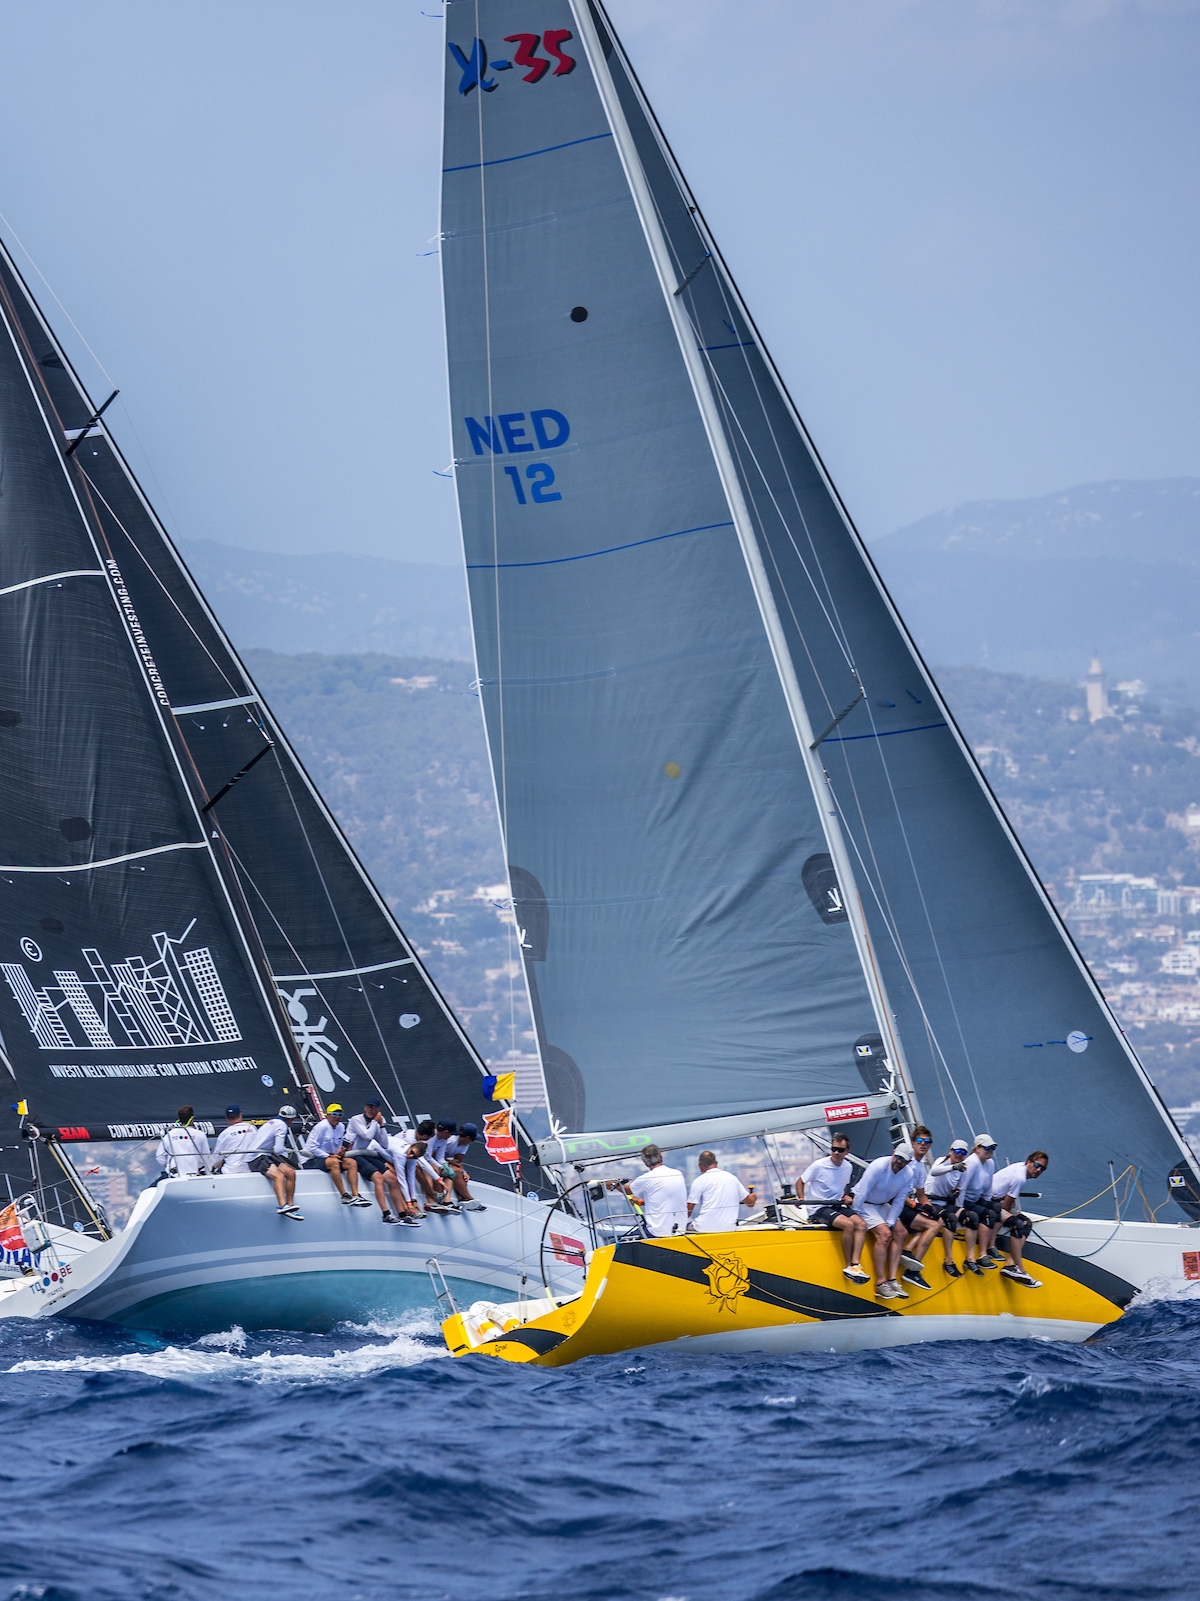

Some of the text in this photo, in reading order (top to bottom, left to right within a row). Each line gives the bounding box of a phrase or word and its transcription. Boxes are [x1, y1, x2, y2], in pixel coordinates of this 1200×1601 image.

[464, 408, 571, 456] NED
[503, 462, 563, 505] 12
[106, 559, 170, 706] CONCRETEINVESTING.COM
[48, 1064, 85, 1078] INVESTI
[157, 1062, 179, 1077] CON
[175, 1060, 214, 1076] RITORNI
[210, 1056, 258, 1074] CONCRETI
[826, 1105, 868, 1119] MAPFRE
